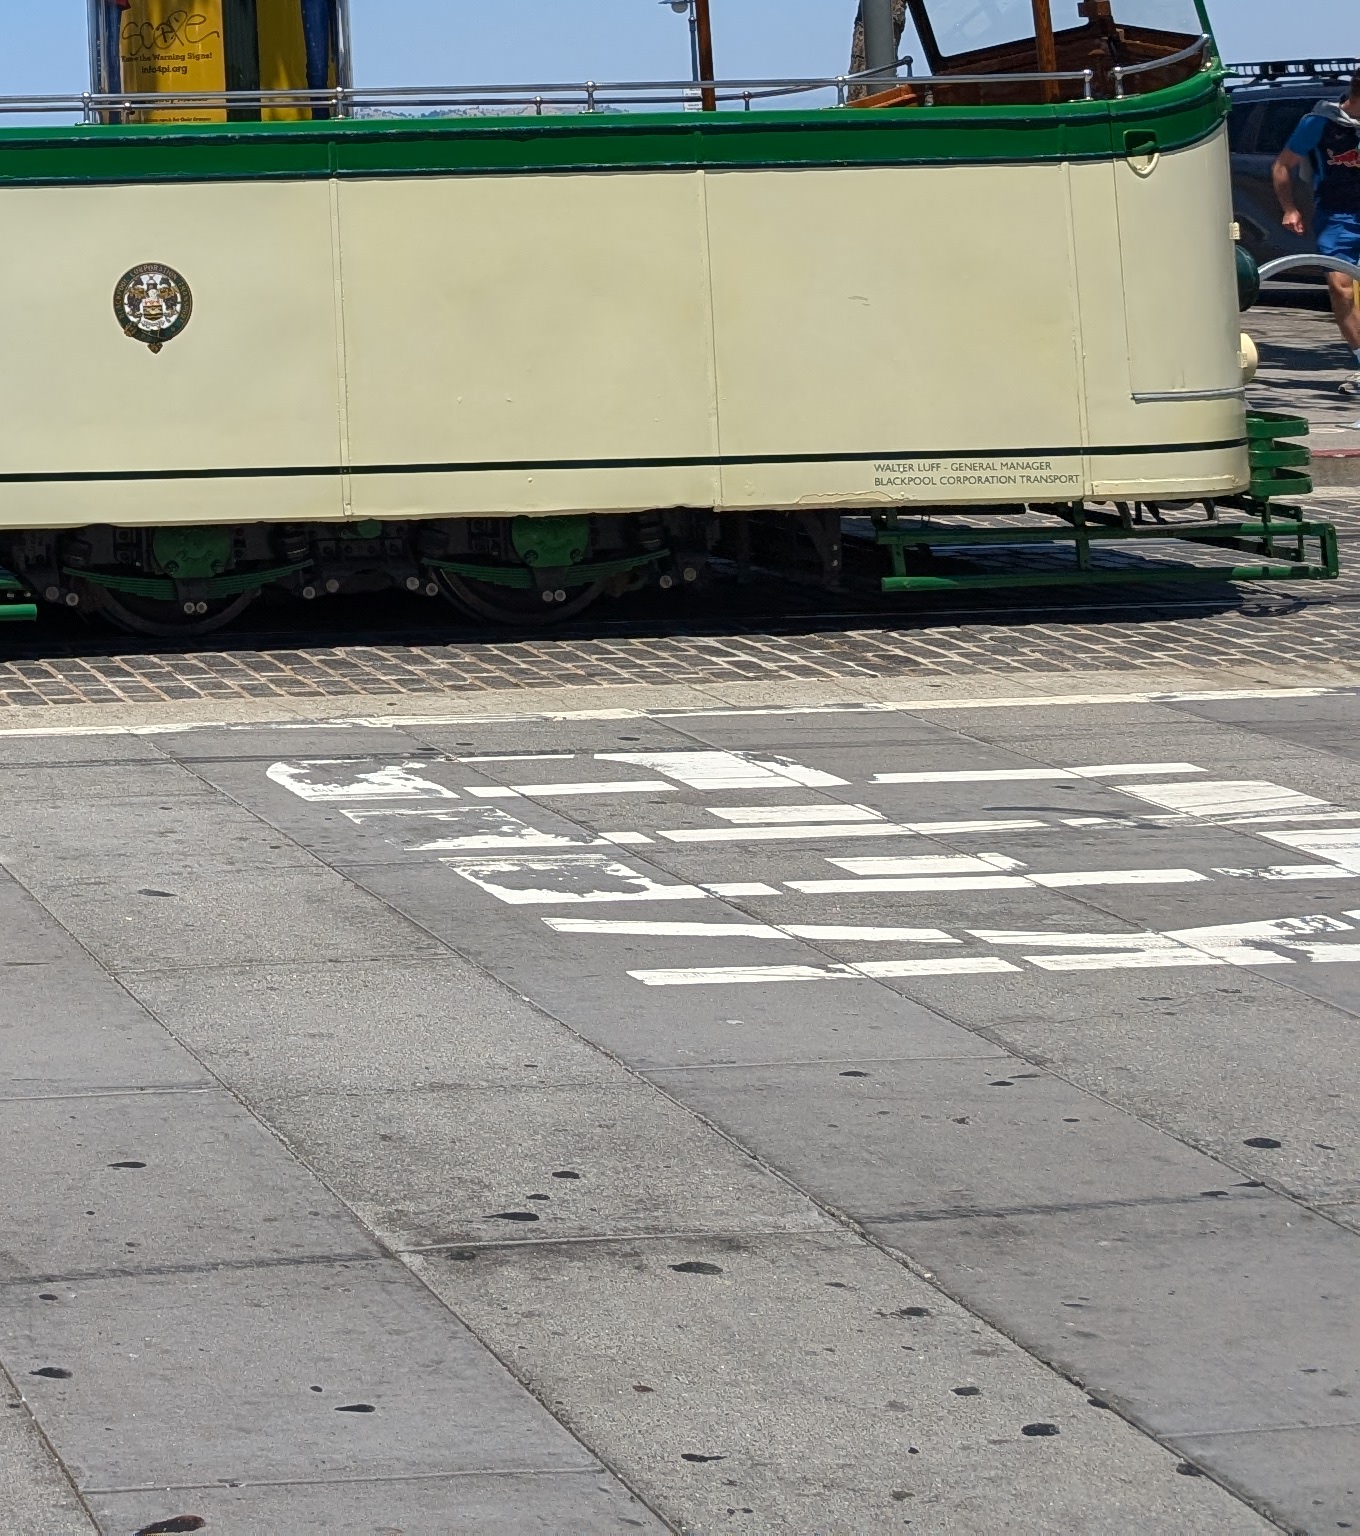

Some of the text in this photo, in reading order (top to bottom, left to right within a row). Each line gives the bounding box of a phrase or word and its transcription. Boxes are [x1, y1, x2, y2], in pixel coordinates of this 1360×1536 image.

[152, 53, 185, 62] Warning
[874, 463, 915, 473] WALTER
[917, 463, 941, 472] LUFF
[951, 462, 998, 472] GENERAL
[1000, 461, 1052, 471] MANAGER
[874, 474, 1080, 486] BLACKPOOL CORPORATION TRANSPORT
